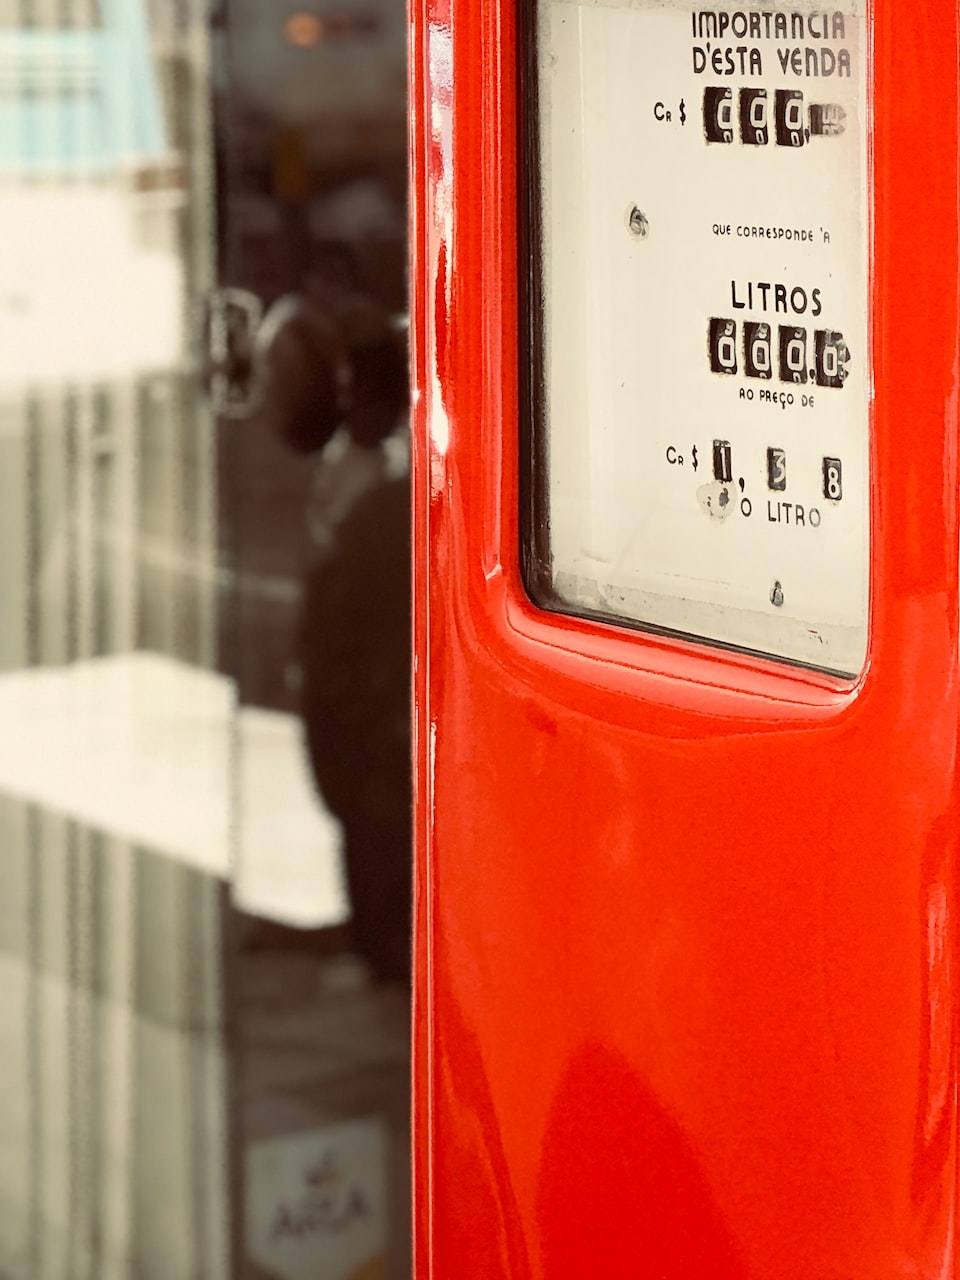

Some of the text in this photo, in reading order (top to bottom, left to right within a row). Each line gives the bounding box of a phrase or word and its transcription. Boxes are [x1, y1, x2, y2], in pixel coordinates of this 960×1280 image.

[691, 9, 846, 40] IMPORTANCIA
[691, 41, 851, 78] D'ESTA VENDA
[712, 223, 731, 237] QUE
[736, 225, 814, 242] CORRESPONDE
[730, 279, 823, 317] LITROS
[738, 387, 815, 411] AO PREÇO DE
[740, 496, 822, 528] O LITRO
